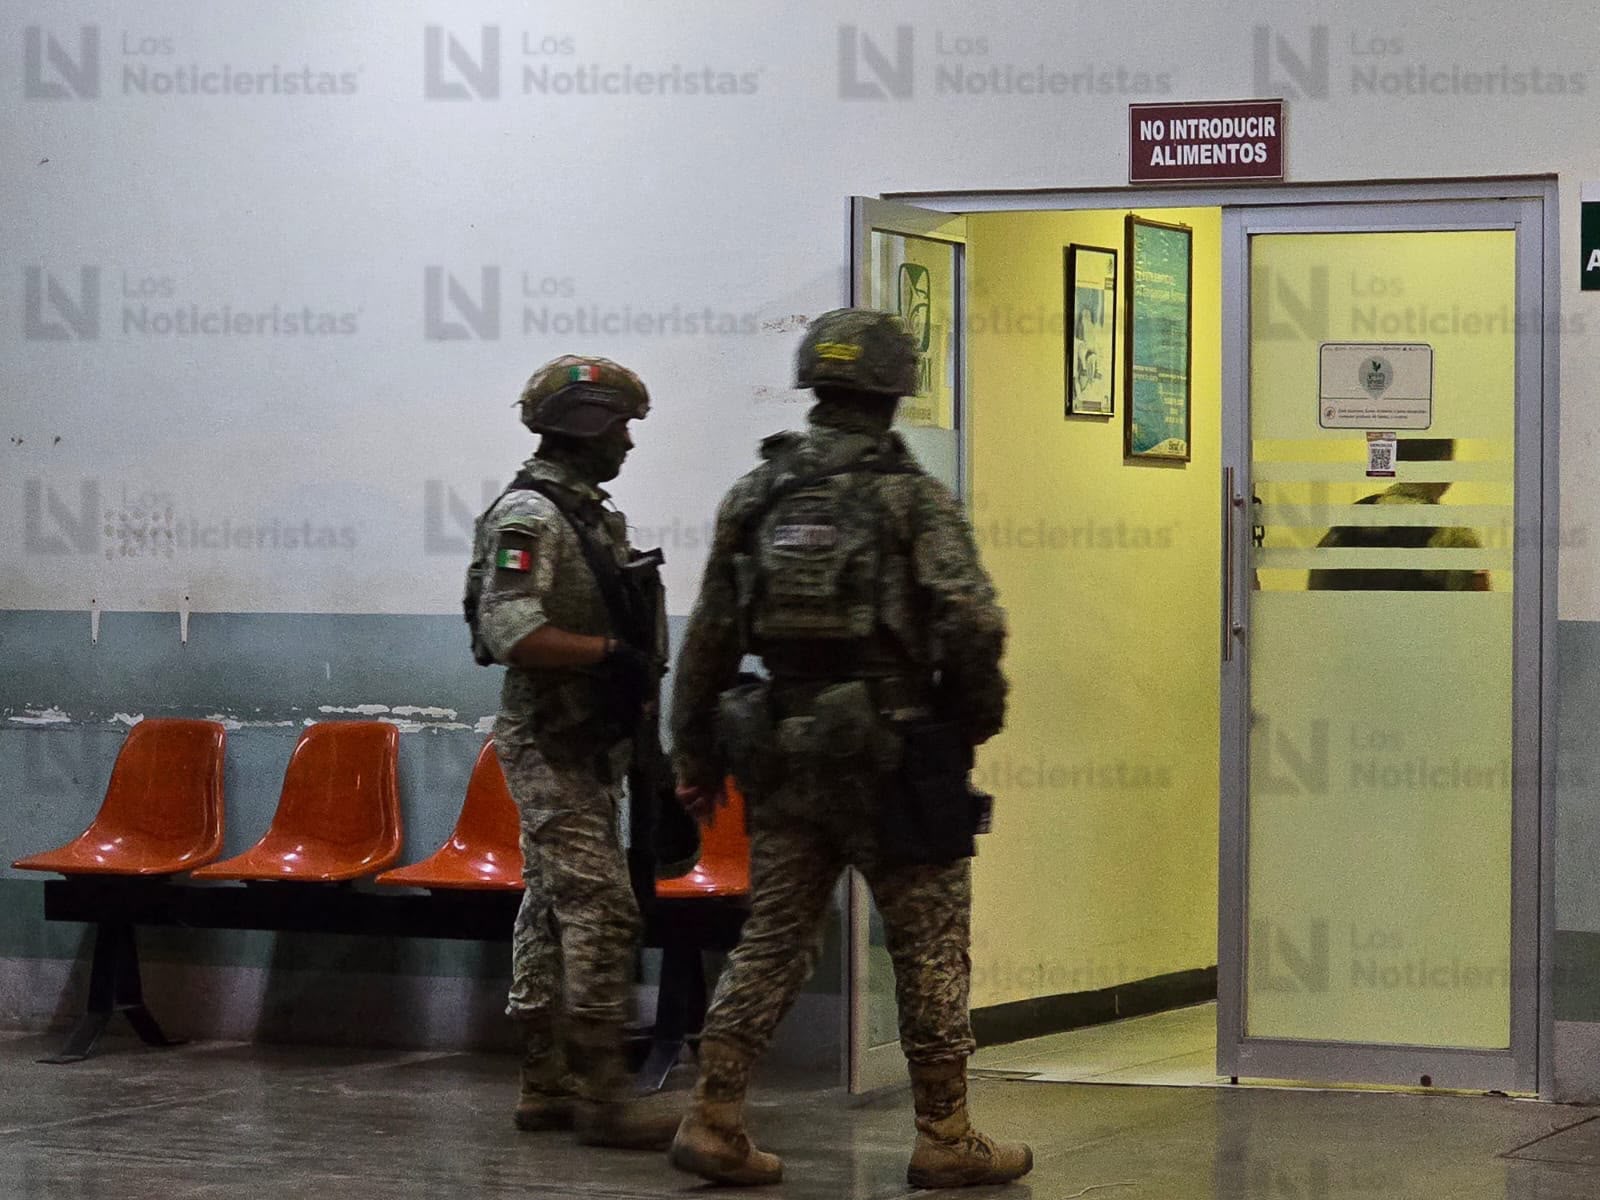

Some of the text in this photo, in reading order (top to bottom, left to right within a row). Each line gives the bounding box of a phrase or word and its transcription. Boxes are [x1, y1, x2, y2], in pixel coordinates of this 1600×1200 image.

[1140, 116, 1276, 141] NO INTRODUCIR
[1150, 142, 1268, 166] ALIMENTOS
